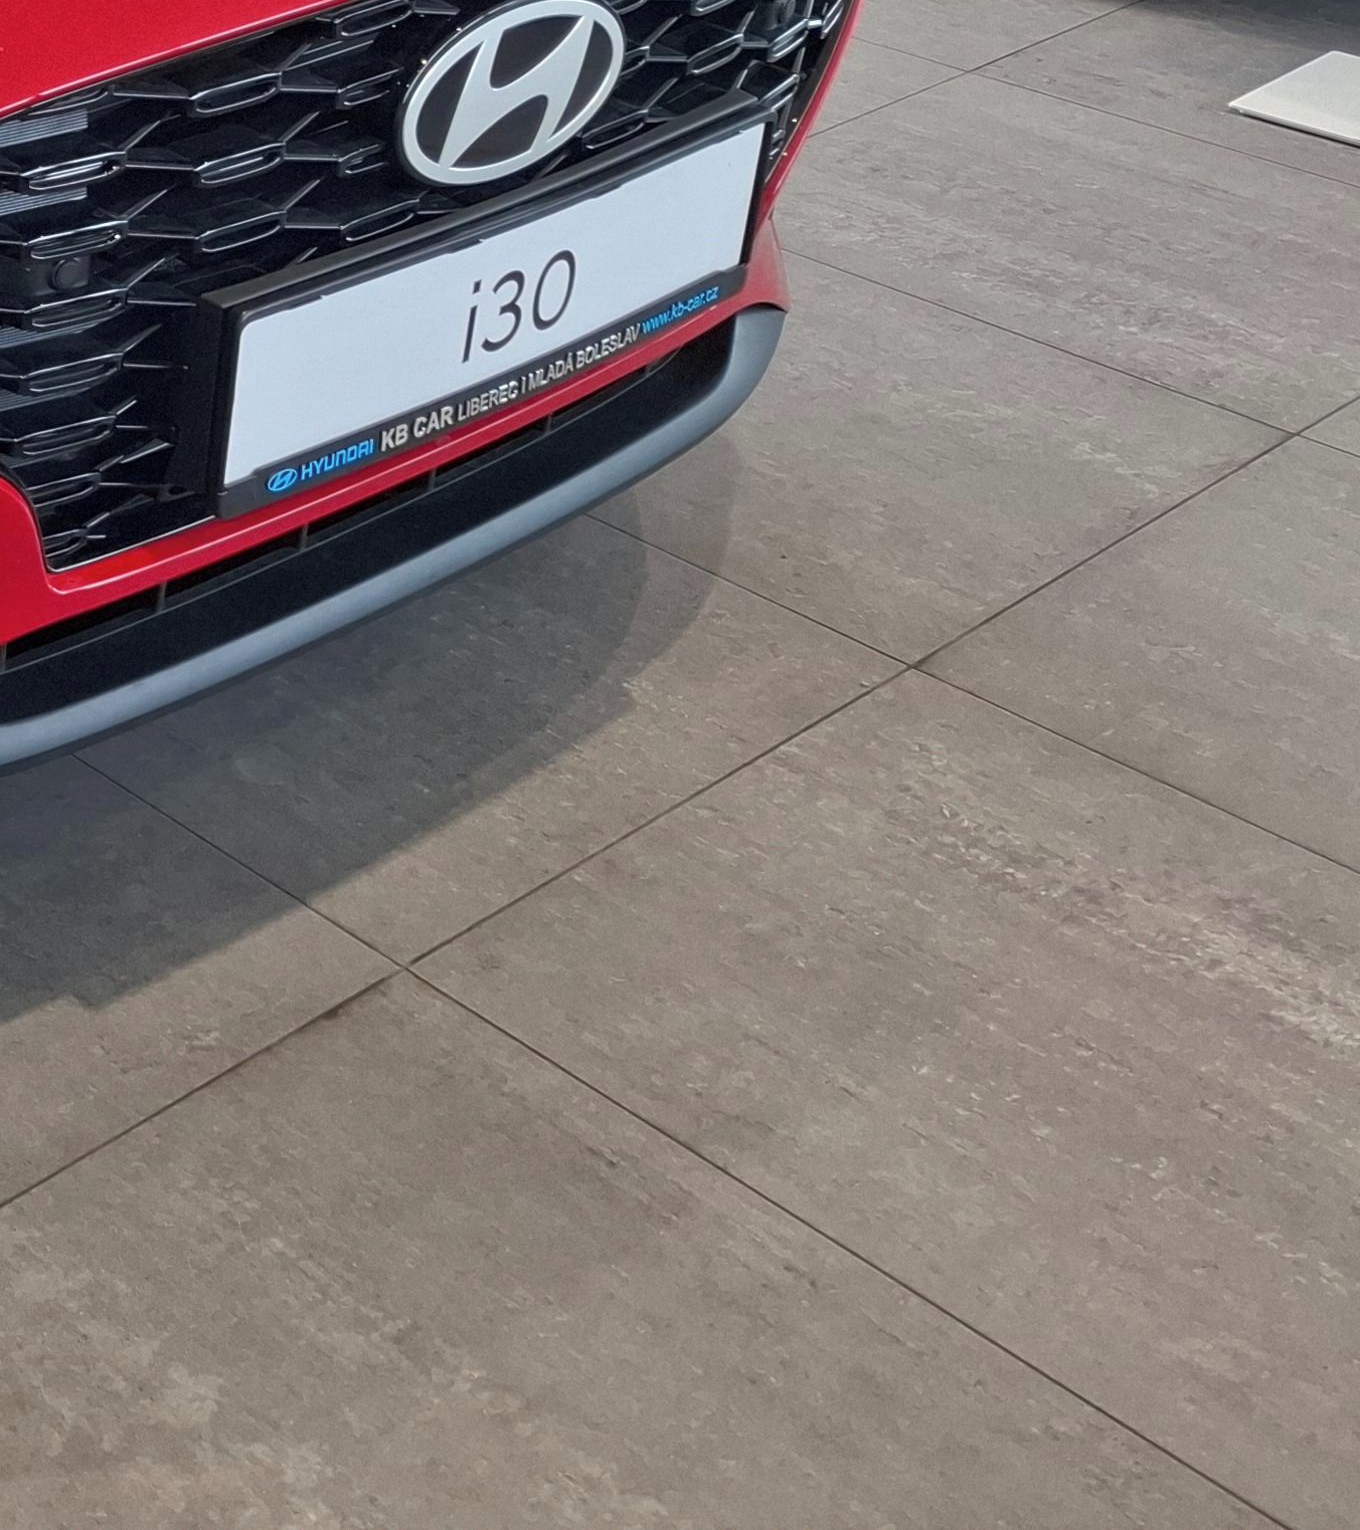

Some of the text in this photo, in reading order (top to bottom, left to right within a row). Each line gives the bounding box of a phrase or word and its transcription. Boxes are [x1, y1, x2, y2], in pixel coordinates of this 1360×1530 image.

[301, 438, 375, 481] HYUNDAI
[381, 423, 409, 452] KB
[413, 405, 455, 438] CAR
[457, 381, 519, 422] LIBEREC
[528, 351, 575, 391] MLADÁ
[575, 323, 641, 370] BOLESLAV
[642, 286, 719, 335] www.kb-car.cz
[461, 249, 576, 364] i30
